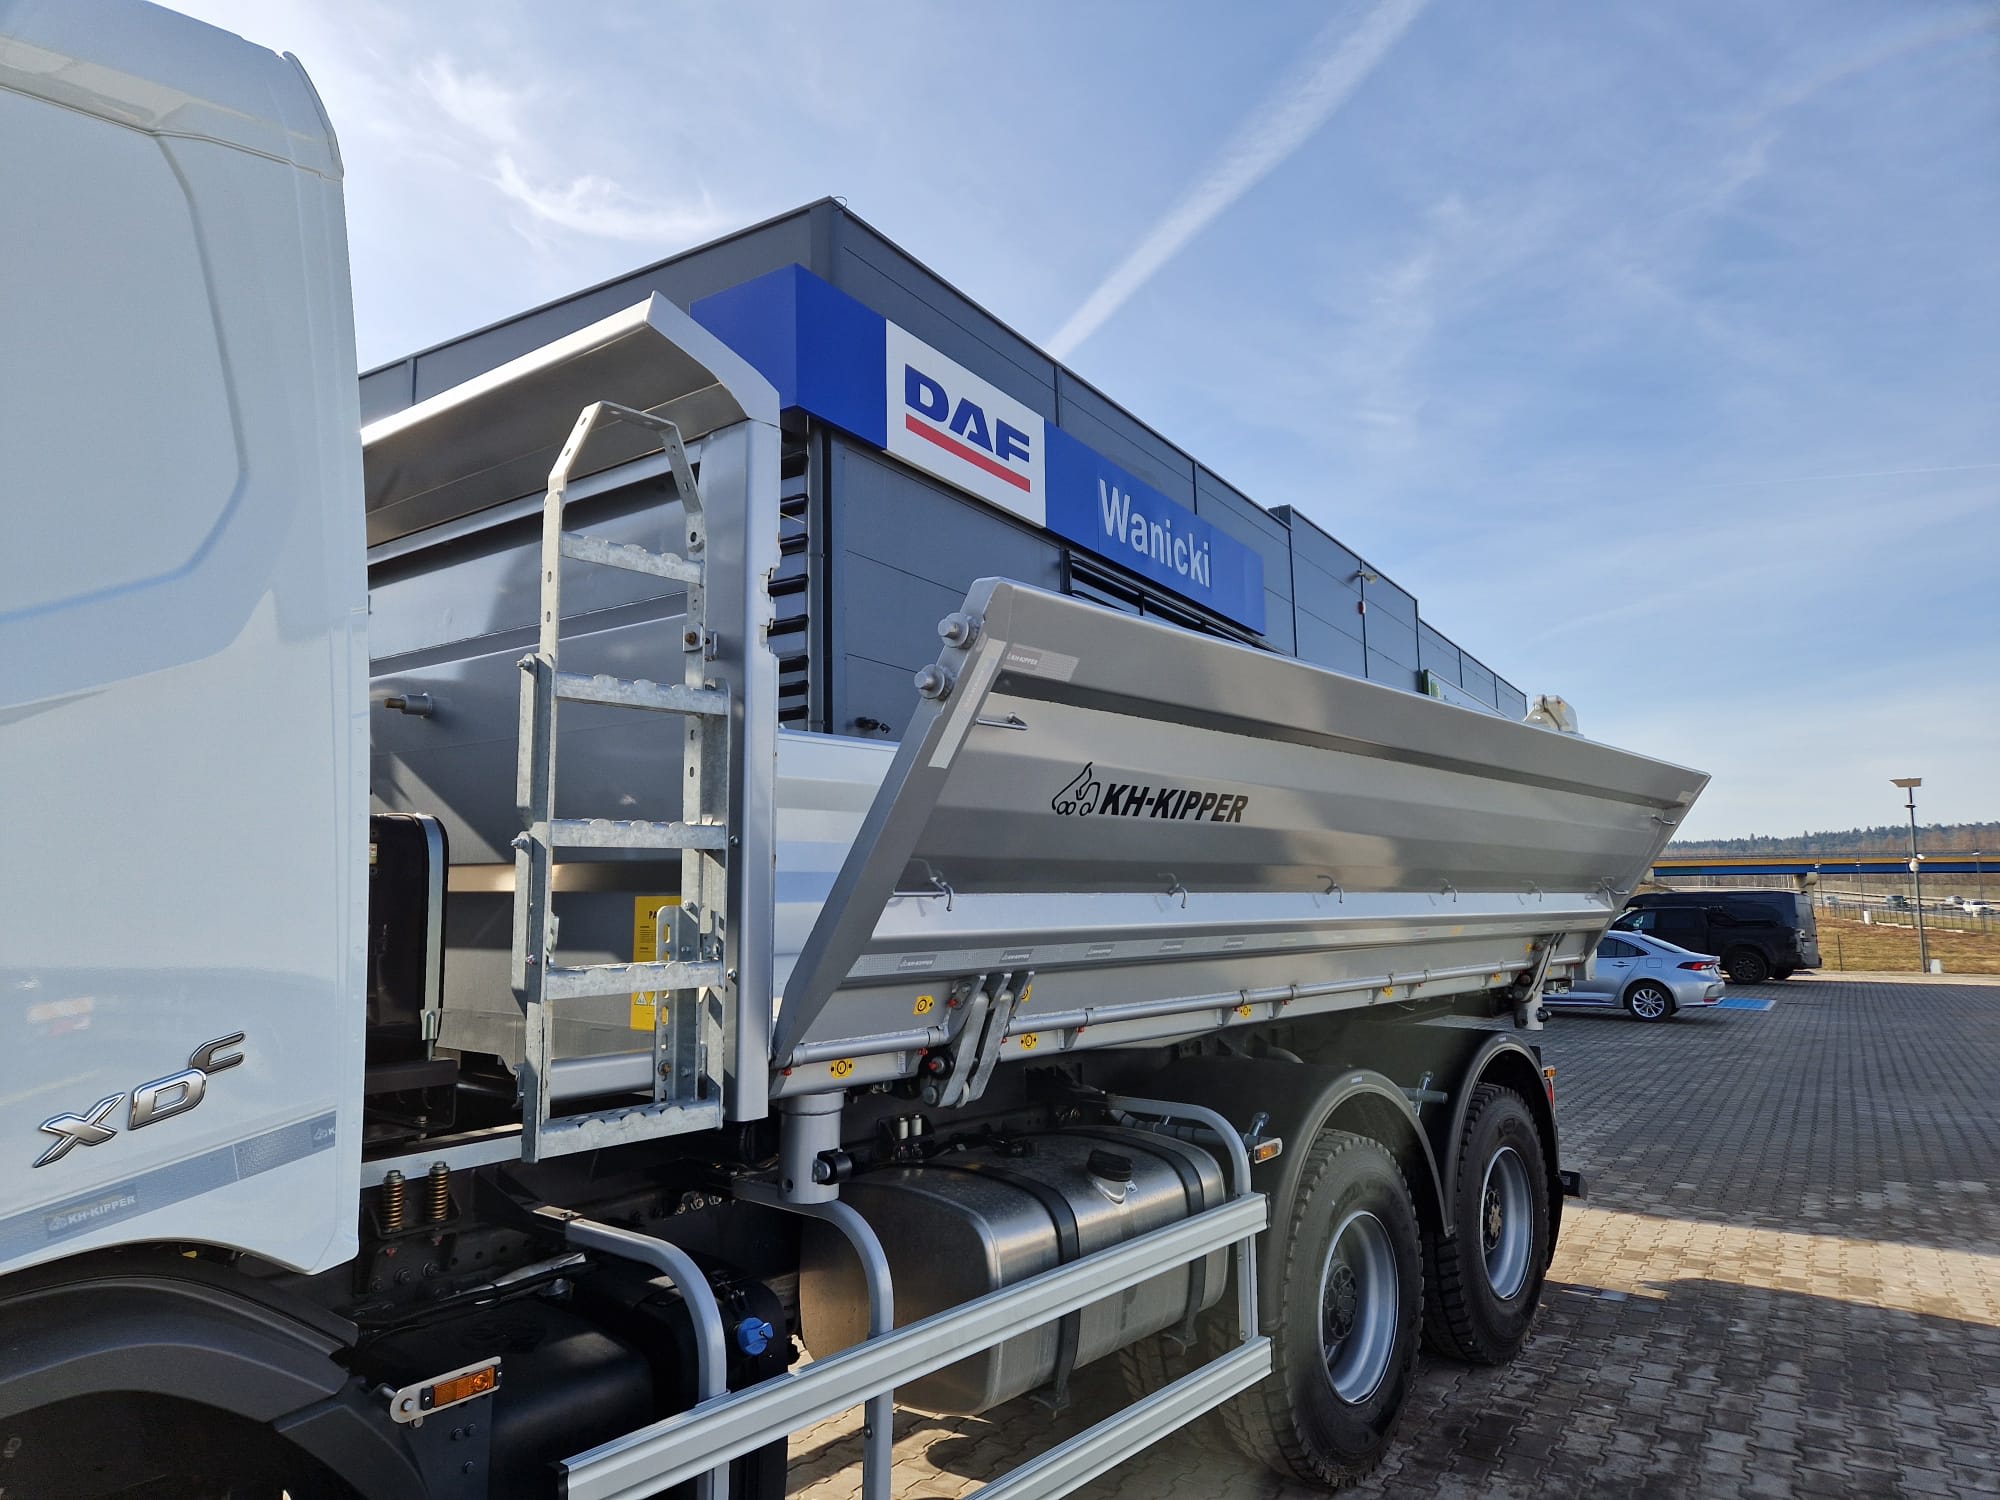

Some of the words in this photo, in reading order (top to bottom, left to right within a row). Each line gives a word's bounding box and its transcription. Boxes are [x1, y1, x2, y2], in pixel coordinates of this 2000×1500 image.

[905, 363, 1030, 463] DAF
[1099, 478, 1210, 588] Wanicki
[1098, 783, 1249, 824] KH-KIPPER
[68, 1195, 136, 1225] KH-KIPPER
